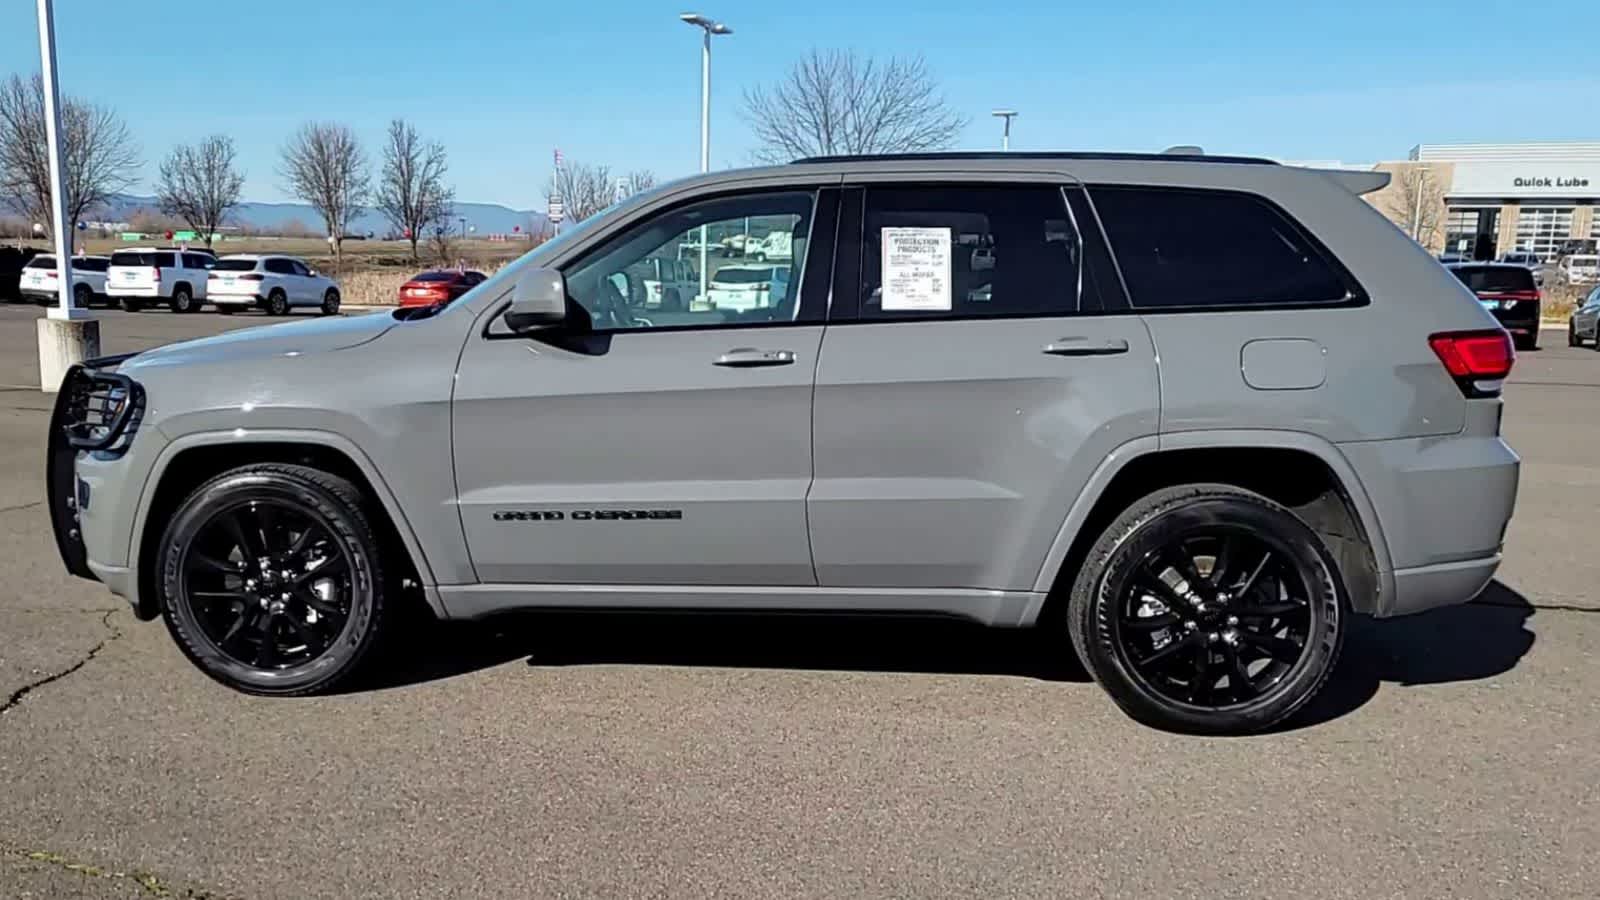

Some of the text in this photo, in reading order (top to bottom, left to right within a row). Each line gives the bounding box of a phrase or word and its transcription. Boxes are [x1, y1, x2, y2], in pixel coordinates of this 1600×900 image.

[1513, 176, 1589, 187] Quick Lube
[894, 238, 940, 246] PROTECTION
[493, 510, 683, 521] GRAND CHEROKEE
